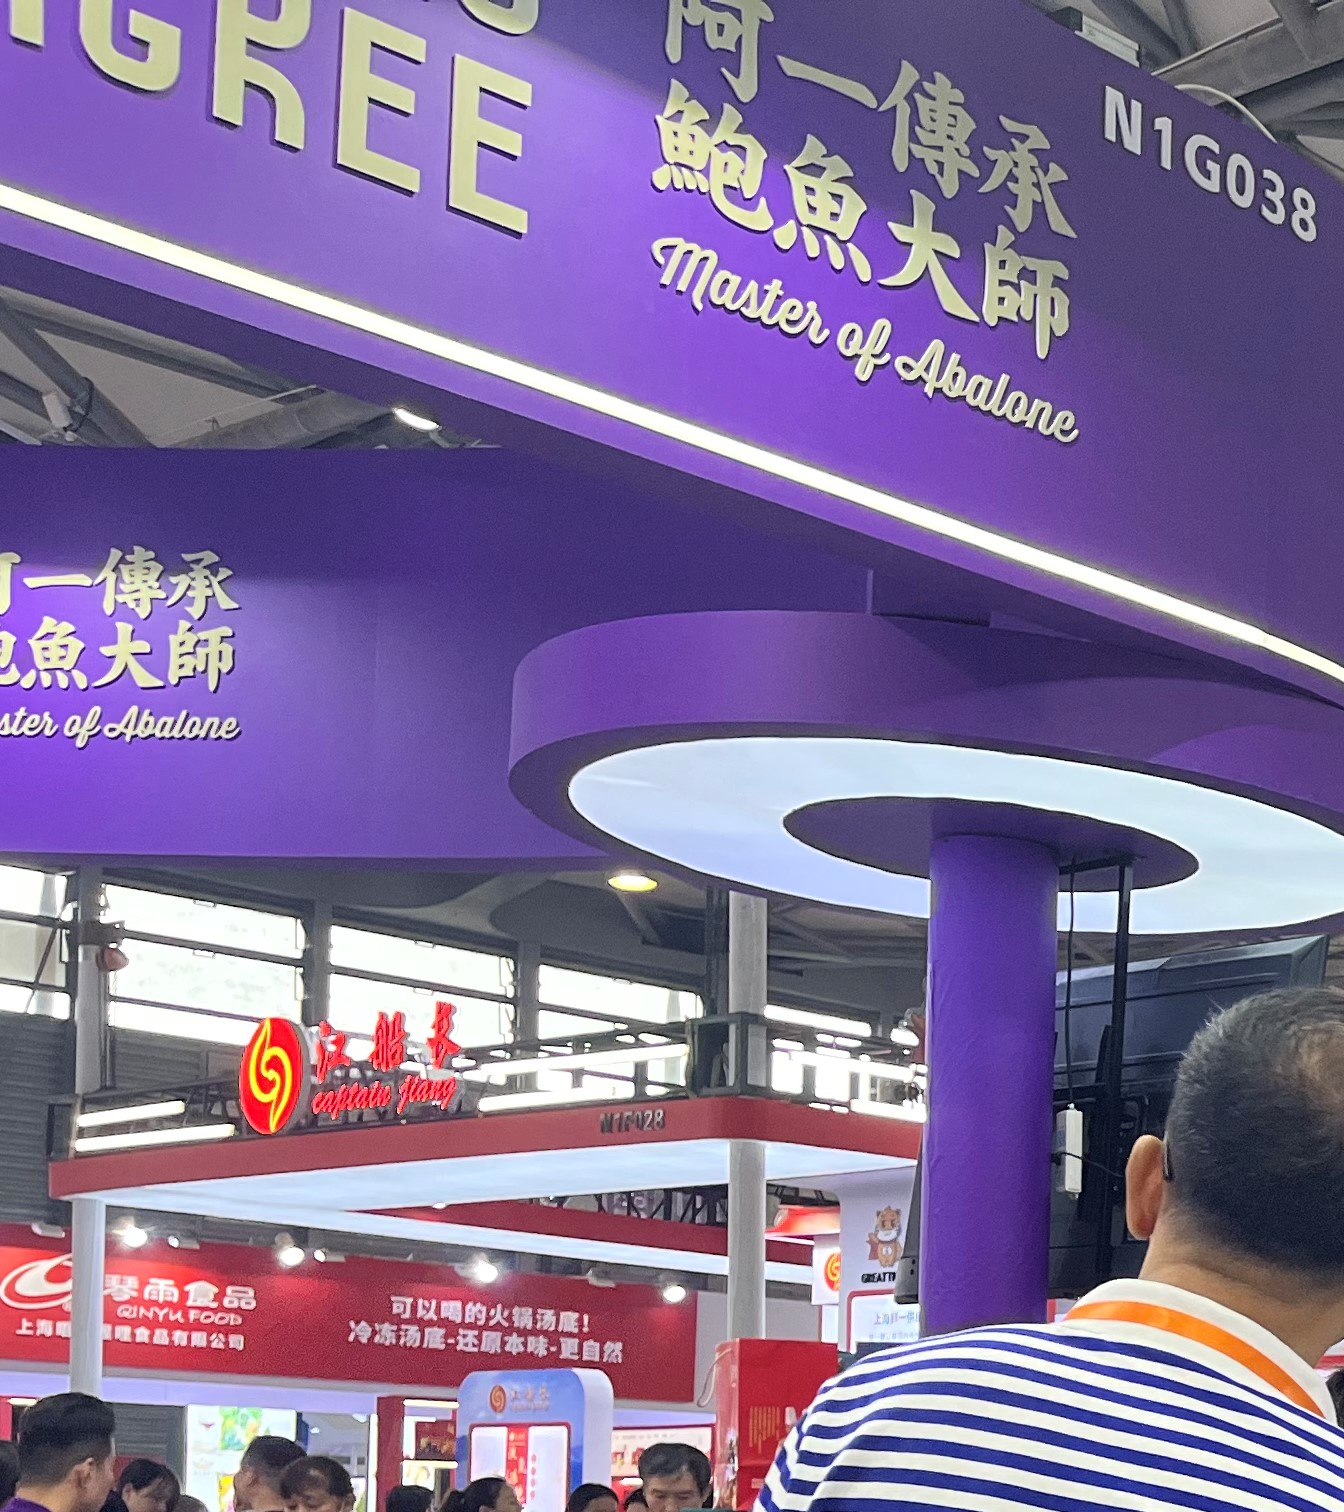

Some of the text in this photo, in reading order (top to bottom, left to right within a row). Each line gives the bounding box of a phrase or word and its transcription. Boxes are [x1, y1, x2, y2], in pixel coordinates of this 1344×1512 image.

[5, 0, 533, 237] GREE
[663, 0, 1078, 240] 阿一傳承
[1103, 84, 1321, 243] N1G038
[651, 77, 1072, 362] 鮑魚大師
[651, 237, 1080, 444] Master of Abalone
[0, 705, 241, 749] ster of Abalone
[104, 1273, 257, 1311] 琴雨食品
[188, 1311, 243, 1326] FOOD
